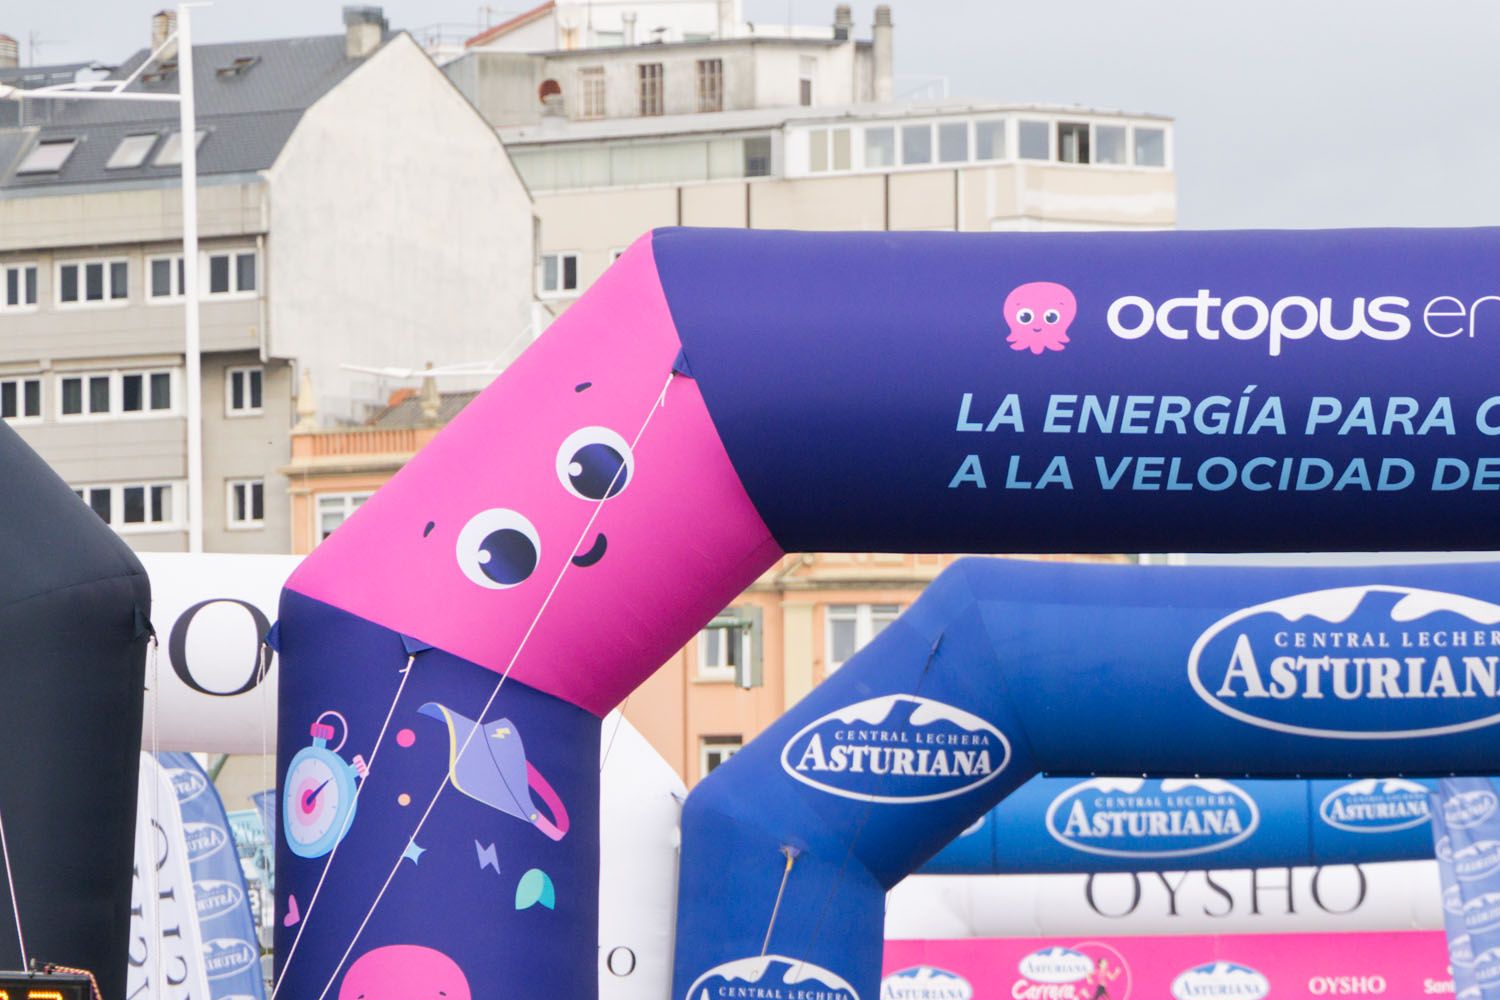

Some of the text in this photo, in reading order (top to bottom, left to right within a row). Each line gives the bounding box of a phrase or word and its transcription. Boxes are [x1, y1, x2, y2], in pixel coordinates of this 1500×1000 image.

[1106, 289, 1411, 356] octopus
[955, 392, 1026, 433] LA
[1042, 385, 1289, 435] ENERGÍA
[1304, 395, 1457, 435] PARA
[949, 455, 989, 488] A
[1005, 455, 1075, 490] LA
[1093, 455, 1417, 492] VELOCIDAD
[1274, 631, 1390, 648] CENTRAL
[834, 730, 990, 746] CENTRAL LECHERA
[796, 733, 992, 777] ASTURIANA
[1062, 799, 1242, 837] ASTURIANA
[1329, 797, 1429, 821] ASTURIANA
[1085, 865, 1367, 917] OYSHO
[719, 986, 782, 999] CENTRAL
[1012, 979, 1075, 1000] Carrera
[1309, 976, 1386, 995] OYSHO
